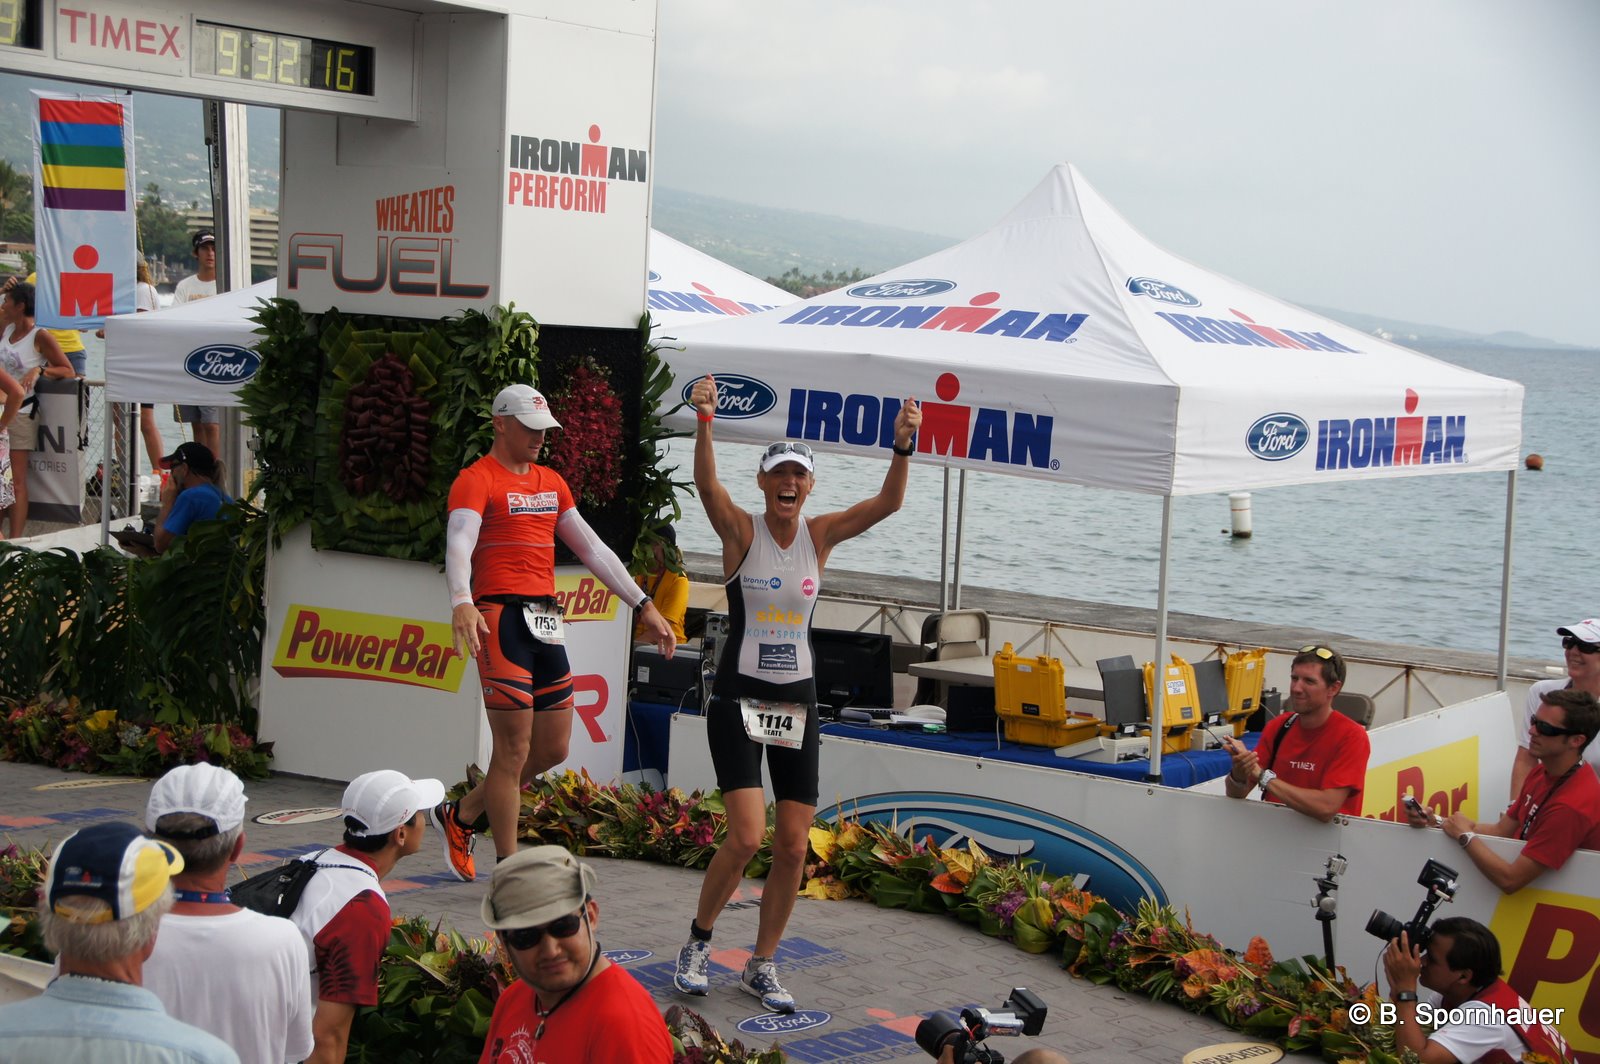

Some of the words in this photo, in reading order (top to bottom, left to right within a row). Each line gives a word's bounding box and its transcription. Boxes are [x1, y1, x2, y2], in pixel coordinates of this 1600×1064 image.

[59, 8, 182, 59] TIMEX
[510, 124, 647, 183] IRONMAN
[376, 185, 455, 233] WHEATIES
[508, 171, 607, 214] PERFORM
[287, 232, 490, 299] FUEL
[864, 281, 937, 297] Ford
[1139, 280, 1191, 305] Ford
[779, 291, 1090, 342] IRONMAN
[1154, 308, 1361, 354] IRONMAN
[199, 350, 246, 378] Ford
[786, 372, 1055, 469] IRONMAN
[1258, 420, 1298, 452] Ford
[1314, 387, 1467, 471] IRONMAN
[530, 499, 559, 508] RACING
[556, 577, 616, 616] erBar
[534, 615, 558, 631] 1753
[755, 603, 803, 625] sikla
[287, 609, 460, 680] PowerBar
[746, 627, 769, 637] KOM
[776, 629, 807, 640] SPORT
[756, 713, 793, 731] 1114
[763, 729, 782, 737] BEATE
[1289, 761, 1316, 771] TIMEX
[754, 1013, 817, 1031] Ford
